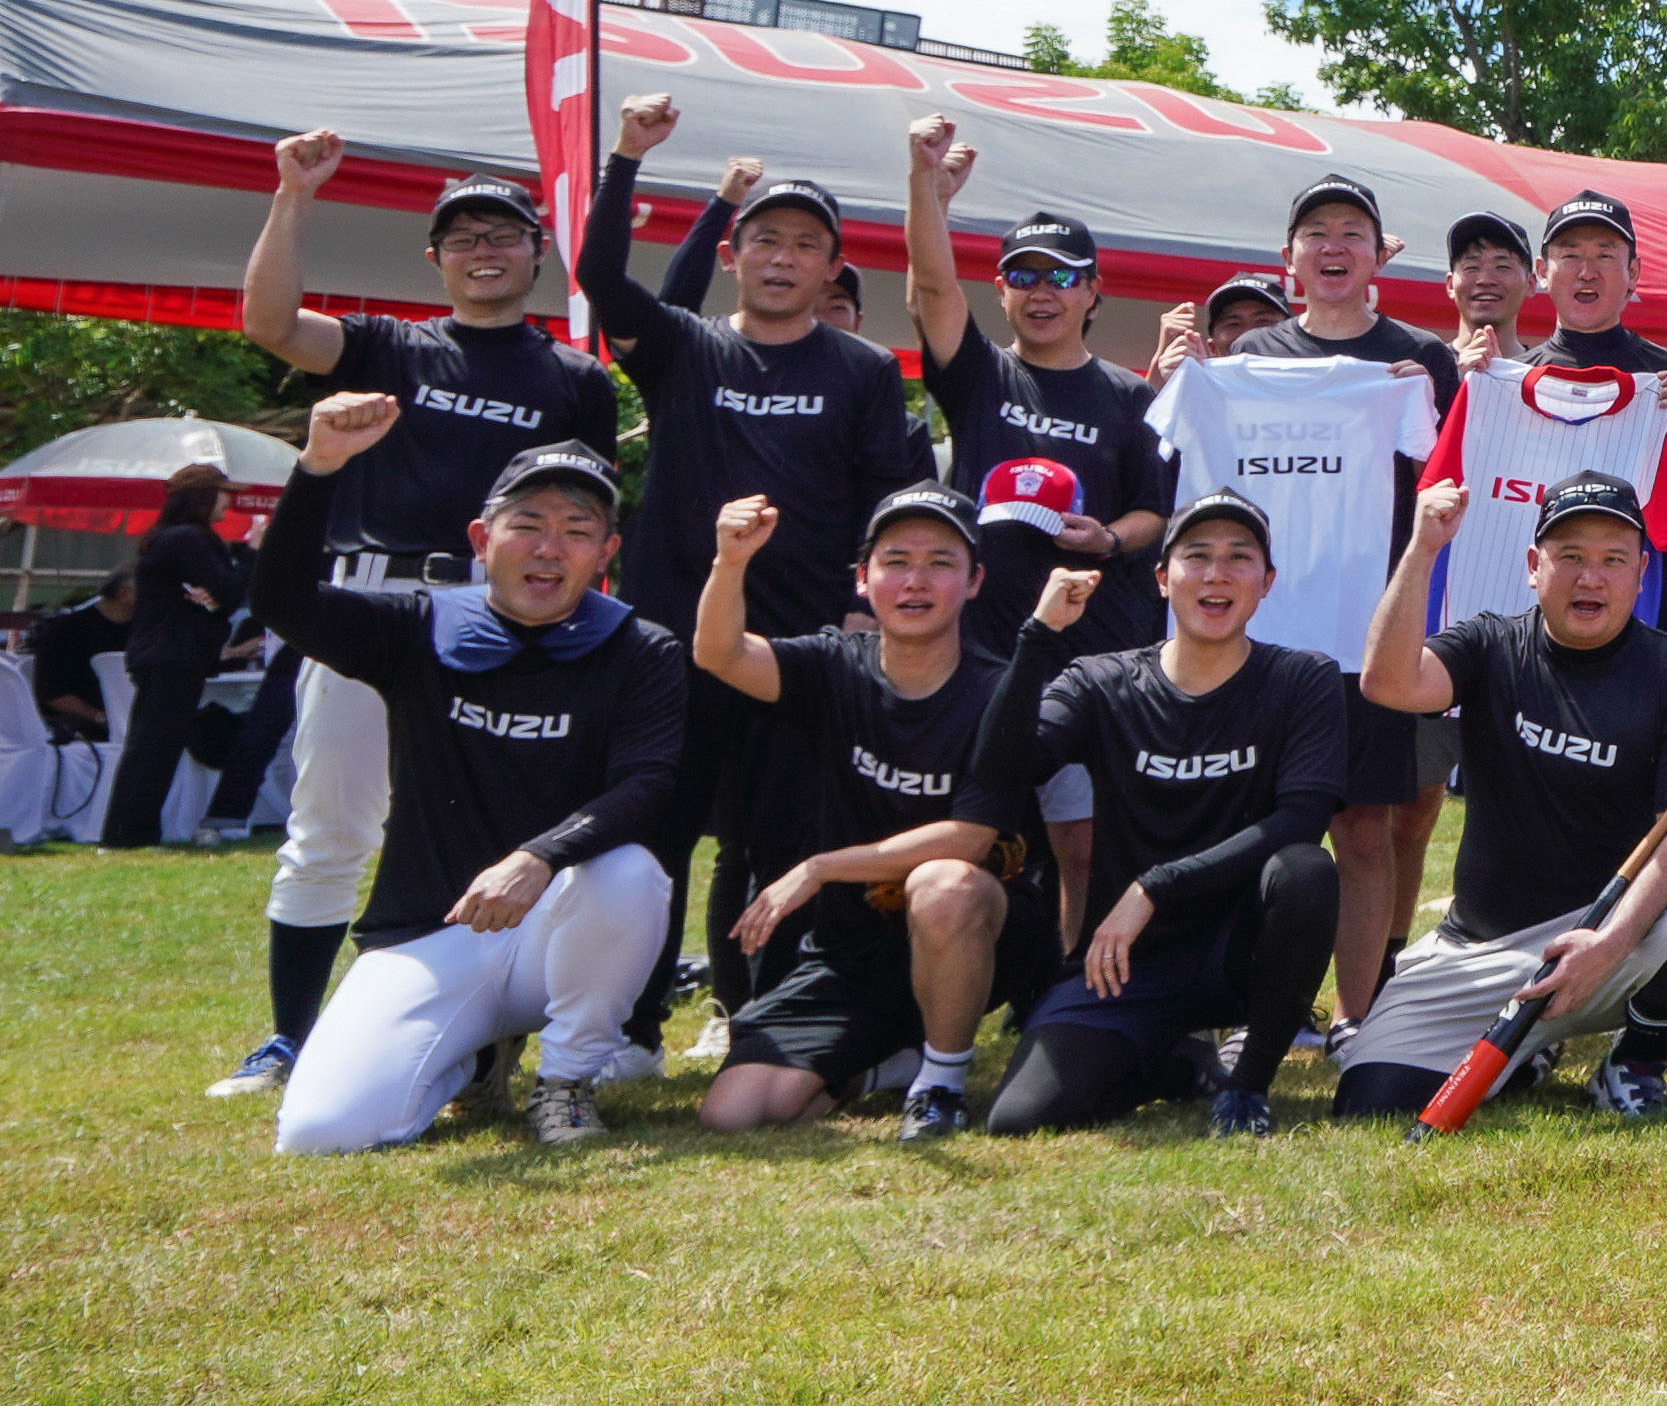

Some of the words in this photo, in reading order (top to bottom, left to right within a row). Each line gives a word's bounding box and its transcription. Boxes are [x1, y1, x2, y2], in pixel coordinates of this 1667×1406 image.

[1563, 201, 1614, 215] ISUZU
[1016, 223, 1071, 239] ISUZU
[415, 385, 544, 430] ISUZU
[714, 386, 824, 416] ISUZU
[1000, 401, 1099, 446] ISUZU
[1236, 456, 1343, 476] ISUZU
[892, 491, 957, 509] ISUZU
[451, 696, 572, 740] ISUZU
[1515, 711, 1618, 769] ISUZU
[853, 746, 952, 796] ISUZU
[1136, 745, 1258, 780] ISUZU
